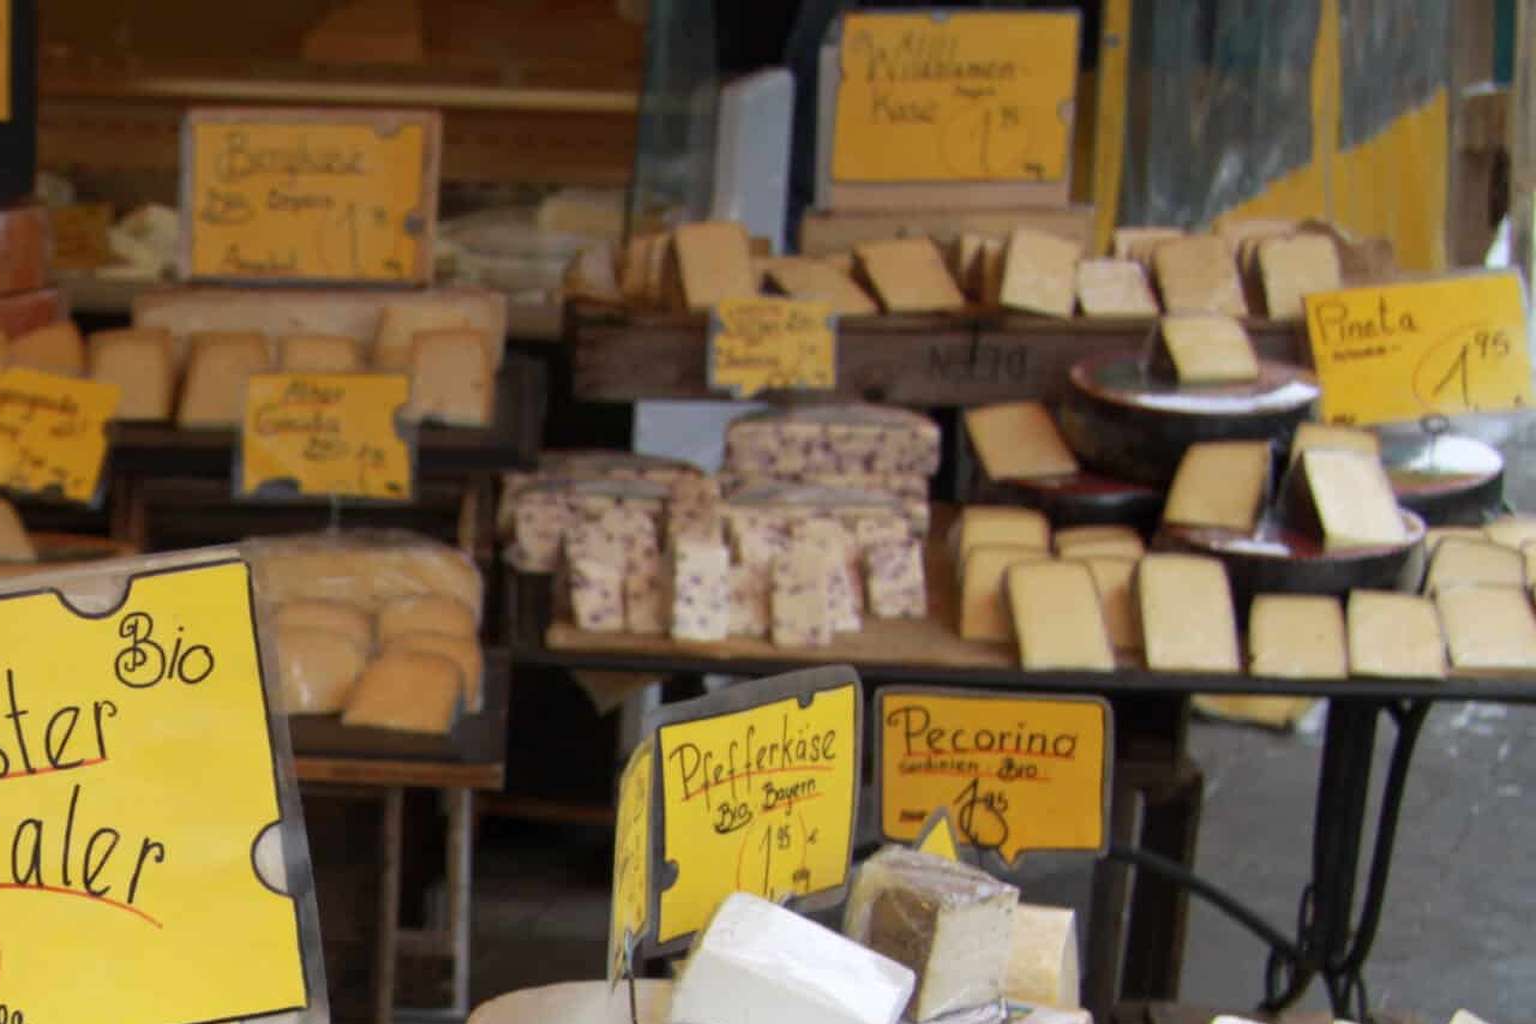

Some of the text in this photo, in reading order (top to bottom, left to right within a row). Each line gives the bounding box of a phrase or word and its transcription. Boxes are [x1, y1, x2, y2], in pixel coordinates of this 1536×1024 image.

[115, 612, 215, 688] Bio
[669, 713, 836, 813] Pfefferkäse
[887, 705, 1078, 757] Pecorino
